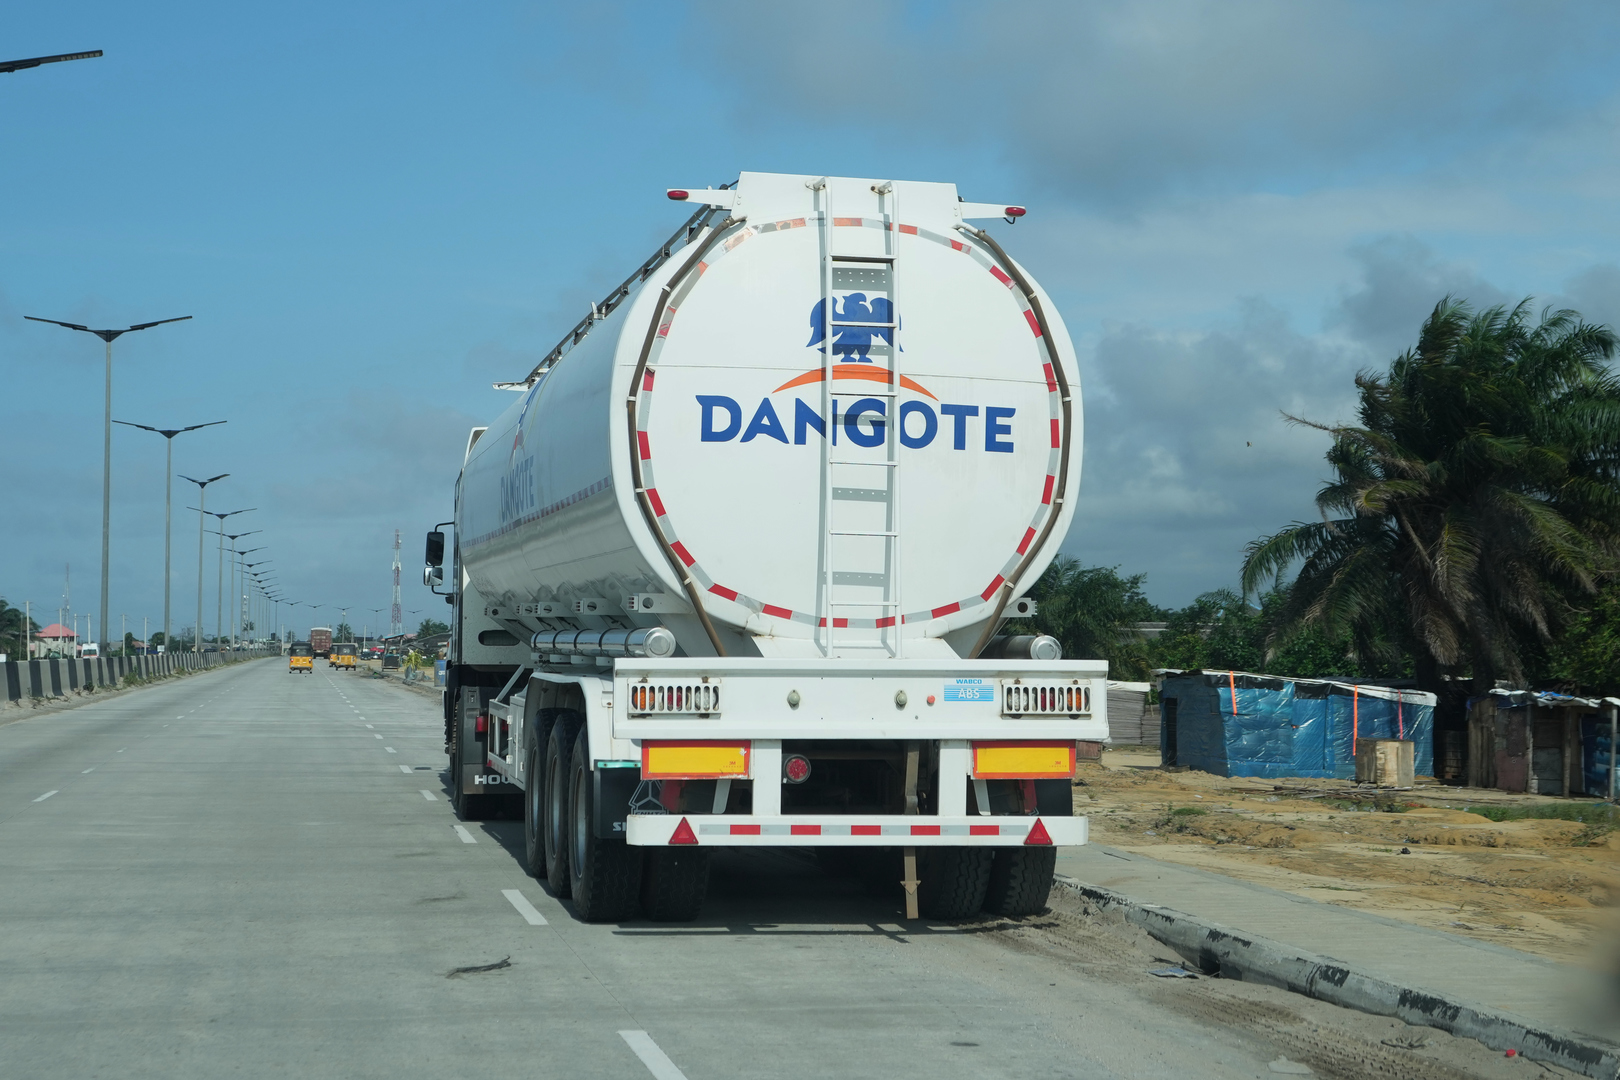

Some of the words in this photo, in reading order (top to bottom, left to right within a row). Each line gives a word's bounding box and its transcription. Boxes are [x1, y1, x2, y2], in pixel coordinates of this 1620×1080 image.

[695, 394, 1017, 454] DANGOTE
[500, 455, 535, 523] DANGOTE
[958, 688, 980, 698] ABS
